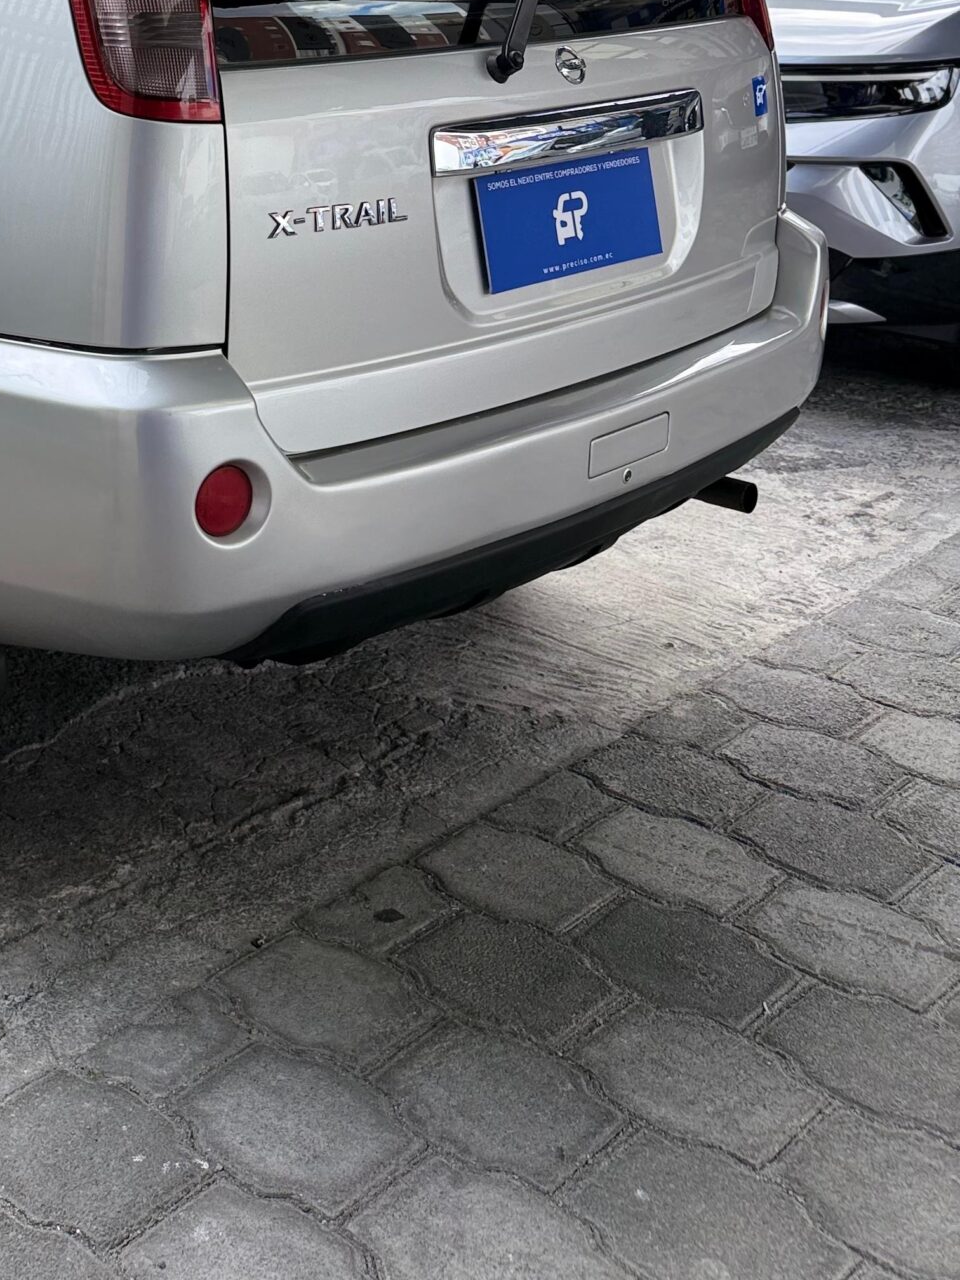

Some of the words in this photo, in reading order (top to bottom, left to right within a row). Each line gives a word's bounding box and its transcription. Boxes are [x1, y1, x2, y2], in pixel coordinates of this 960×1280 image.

[487, 180, 510, 191] SOMOS
[510, 178, 518, 187] EL
[517, 175, 535, 185] NEXO
[534, 171, 554, 182] ENTRE
[554, 163, 598, 179] COMPRADORES
[602, 156, 640, 170] VENDEDORES
[267, 197, 408, 239] X-TRAIL
[542, 252, 614, 274] www.preciso.com.ec
